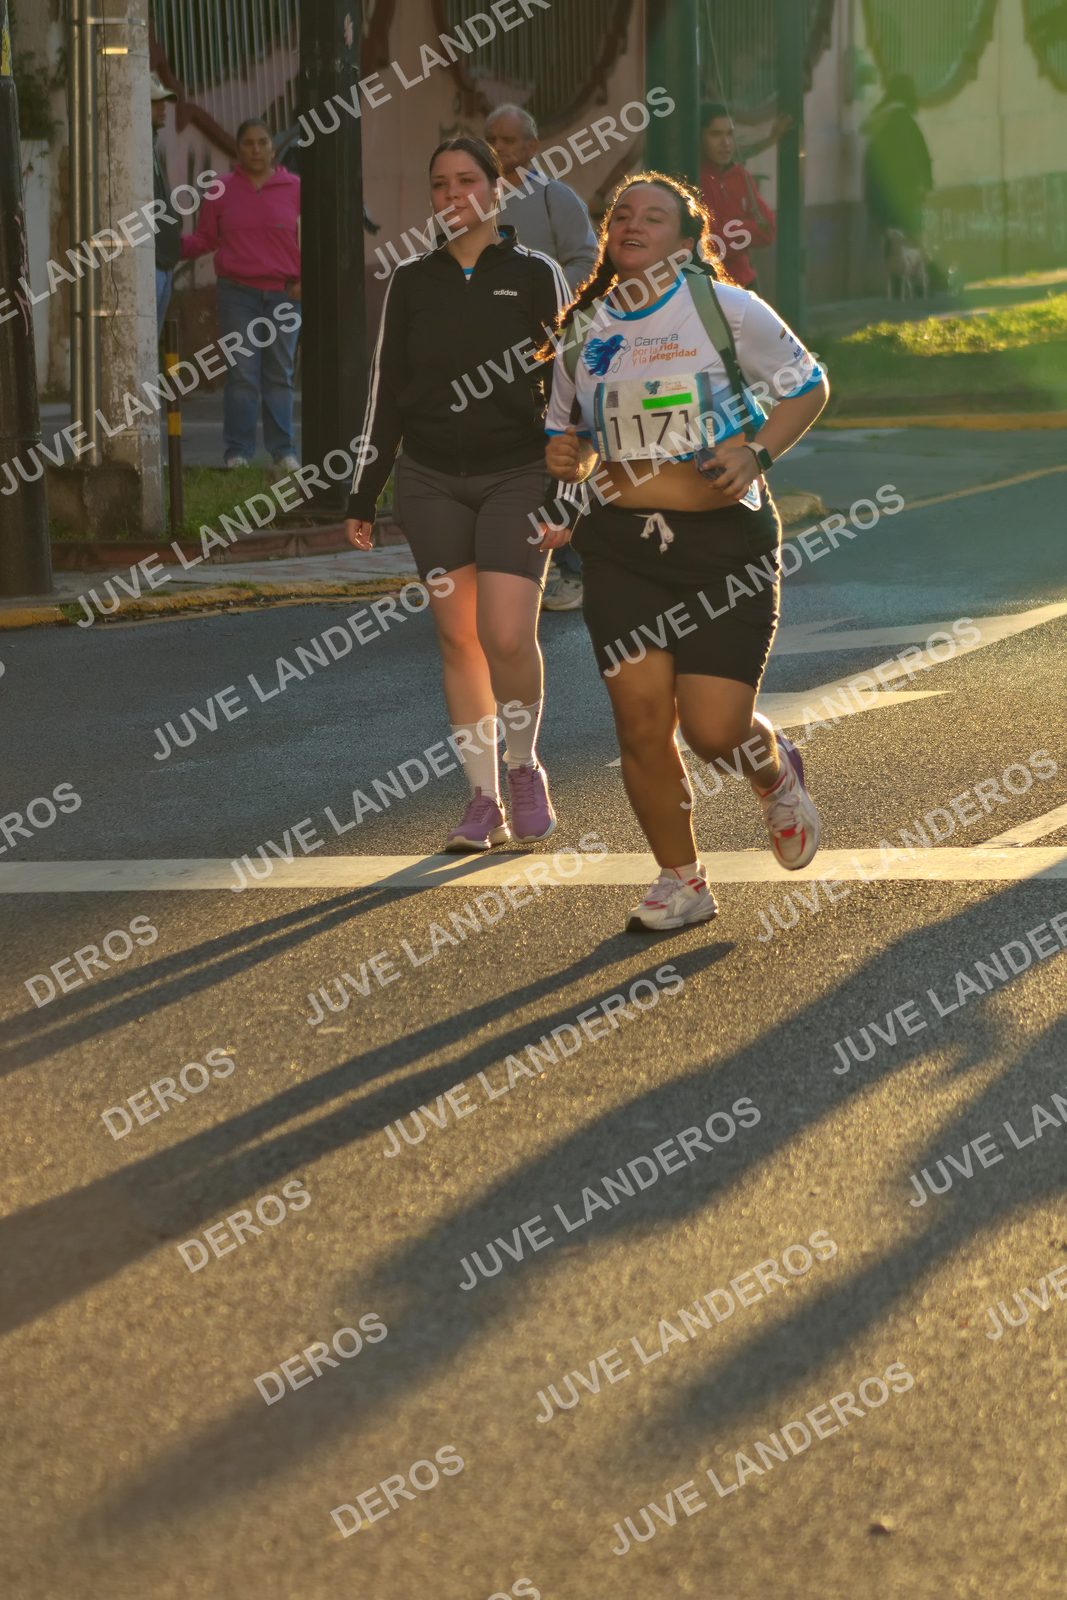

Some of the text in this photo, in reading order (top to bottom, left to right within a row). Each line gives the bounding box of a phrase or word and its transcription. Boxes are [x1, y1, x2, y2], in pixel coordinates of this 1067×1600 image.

[493, 289, 518, 297] adidas
[634, 333, 679, 347] Carrea
[610, 409, 691, 450] 1171
